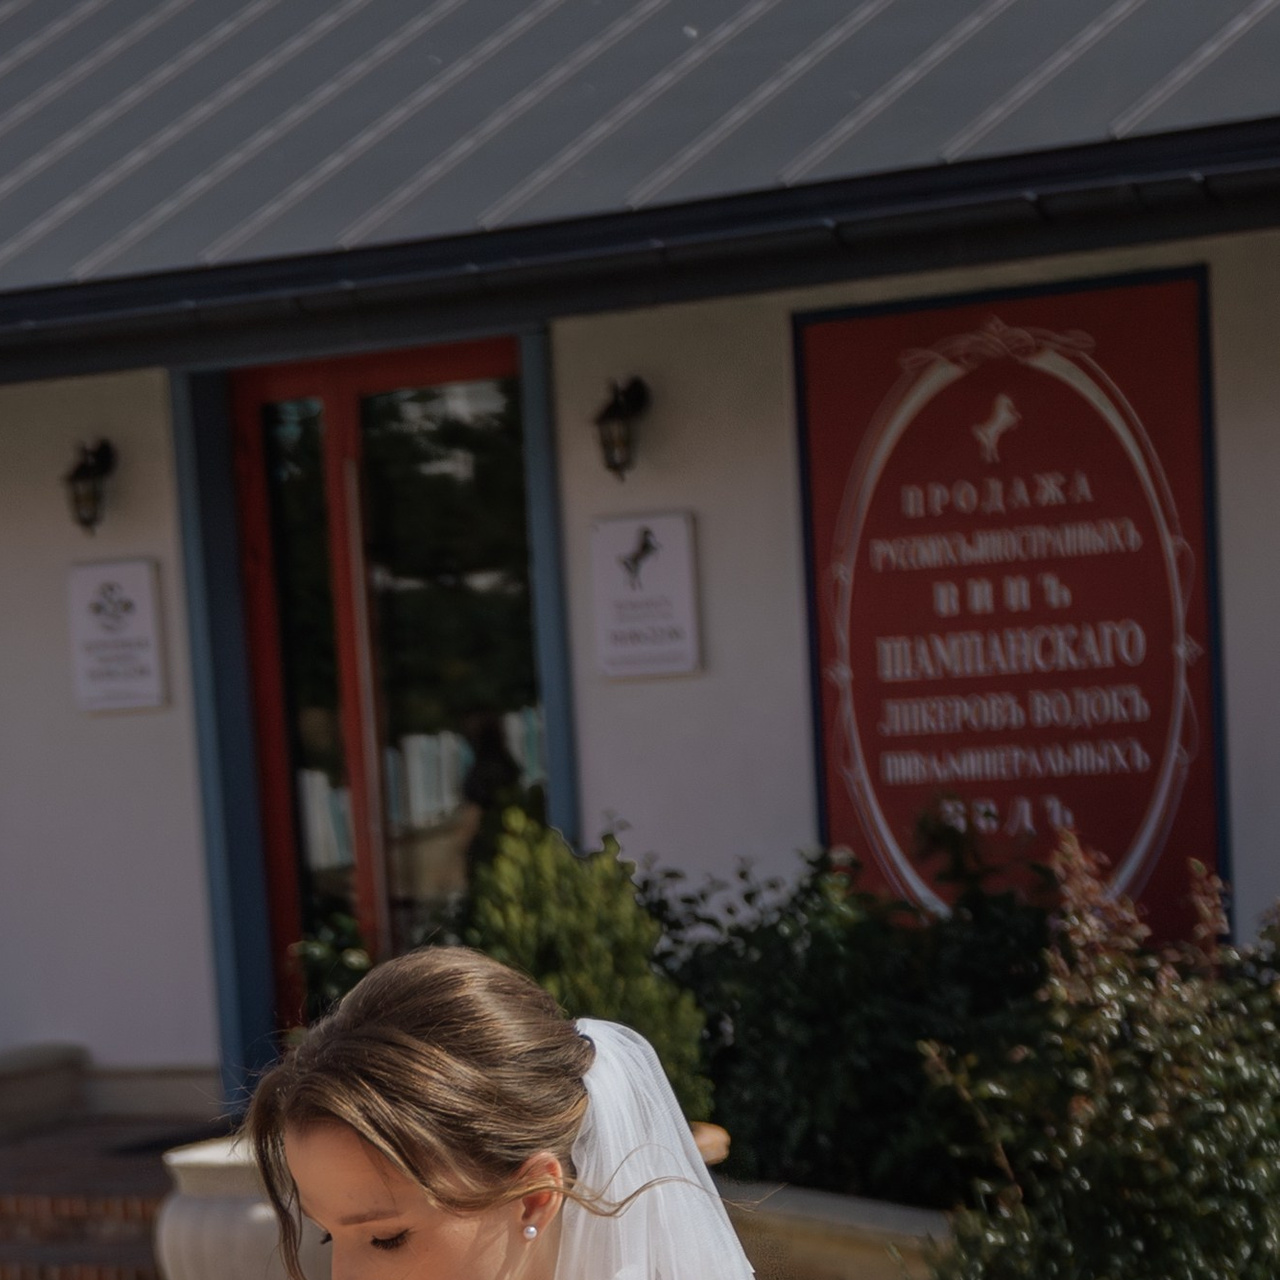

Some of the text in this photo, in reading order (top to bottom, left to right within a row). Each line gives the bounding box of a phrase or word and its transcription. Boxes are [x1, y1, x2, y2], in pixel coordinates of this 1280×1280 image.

[901, 471, 1093, 518] ПРОДАЖА
[933, 573, 1072, 617] ВИНЪ
[877, 619, 1146, 681] ШАМПАНСКАГО
[1029, 685, 1150, 729] ВОДОКЪ
